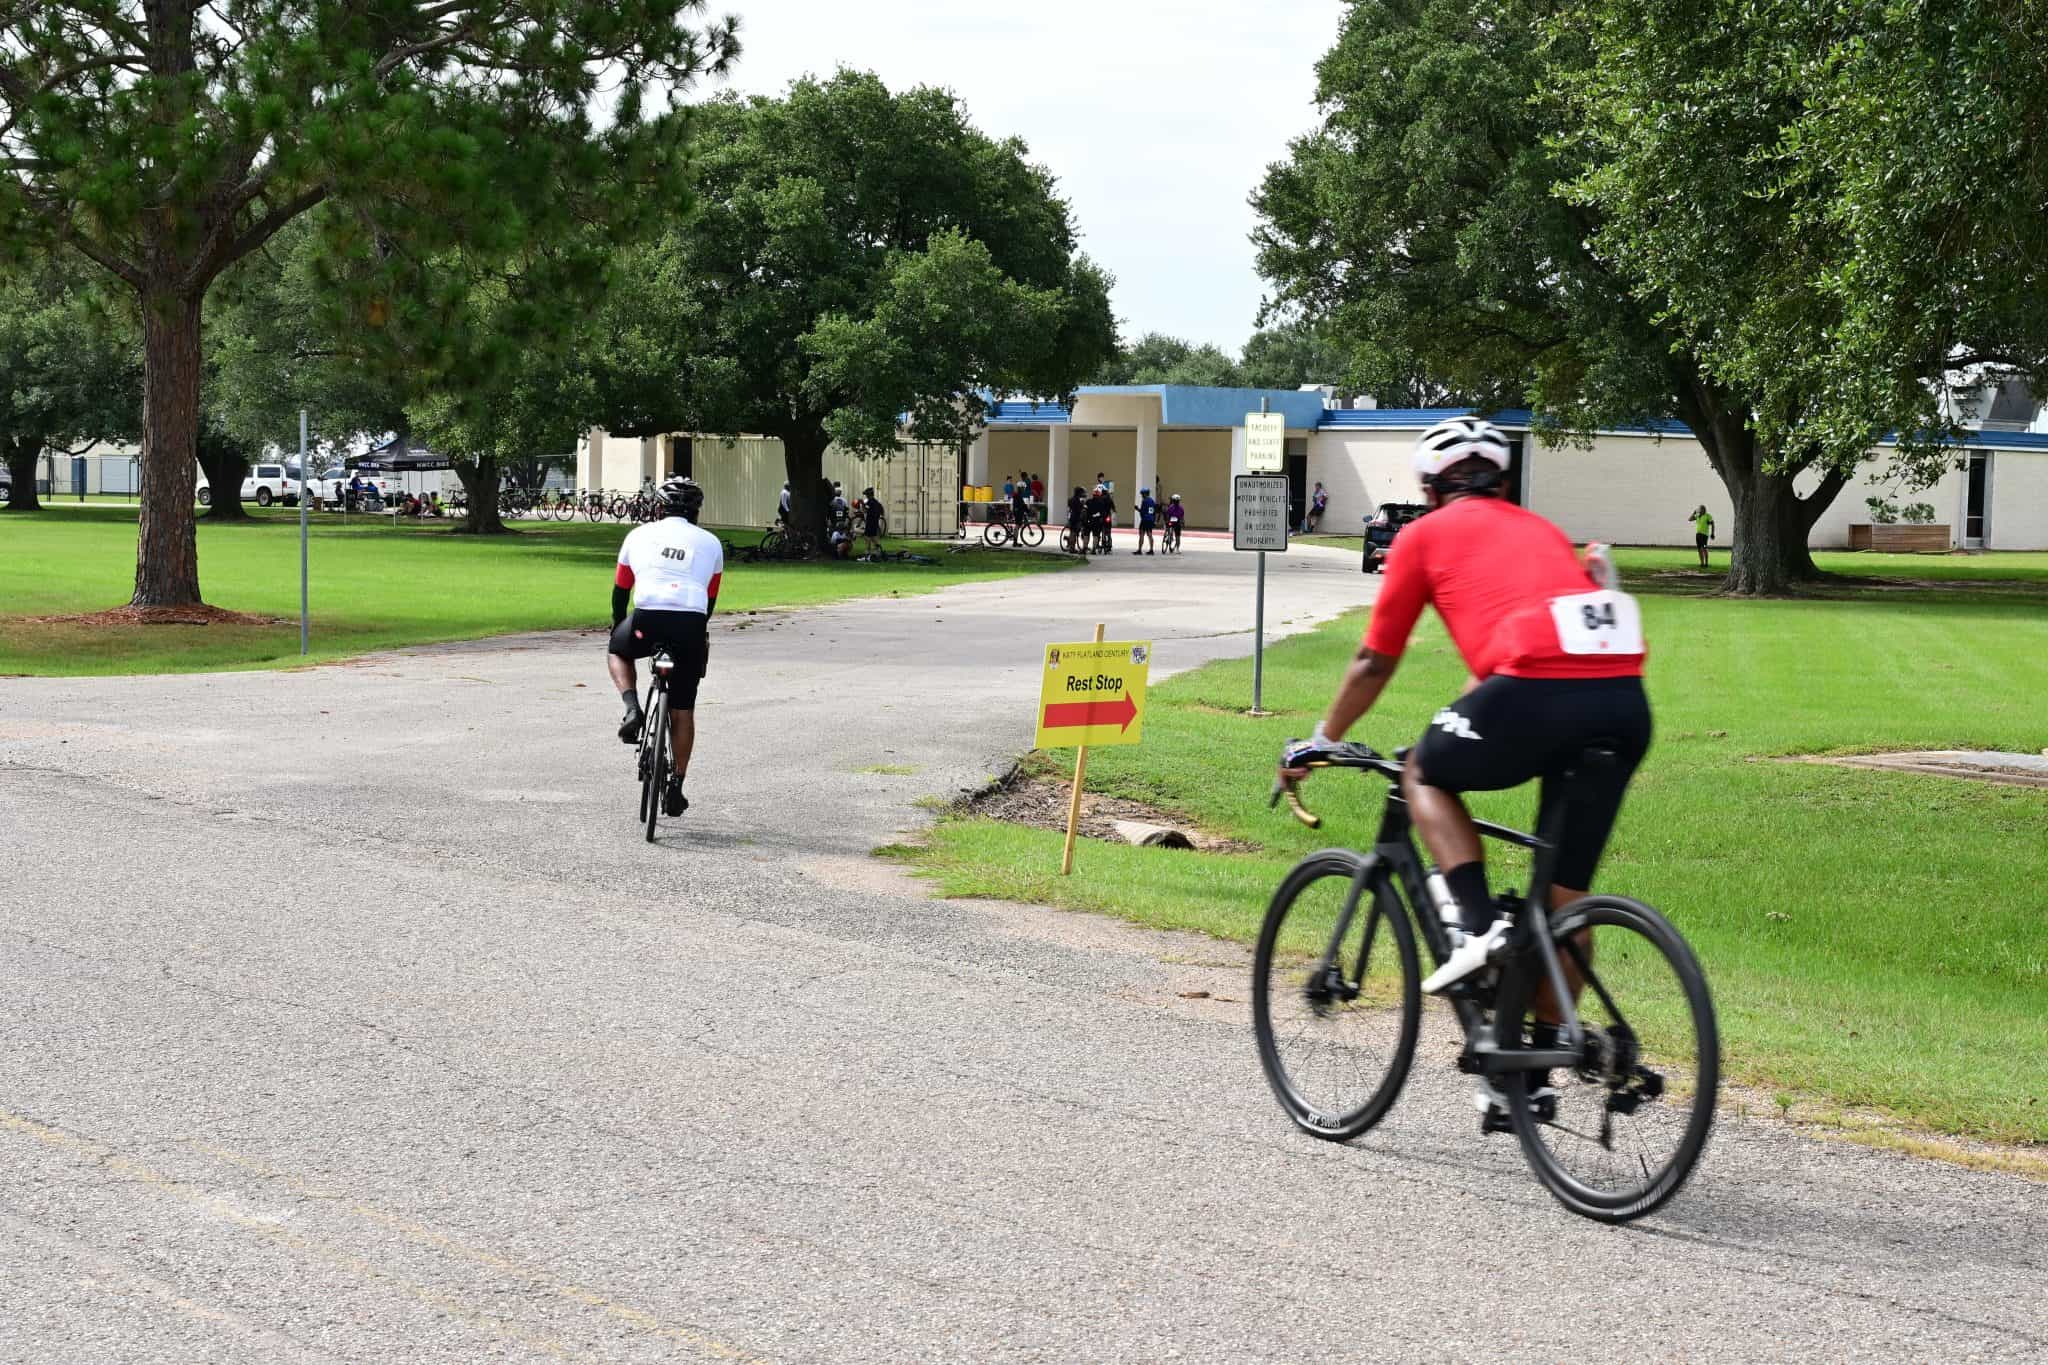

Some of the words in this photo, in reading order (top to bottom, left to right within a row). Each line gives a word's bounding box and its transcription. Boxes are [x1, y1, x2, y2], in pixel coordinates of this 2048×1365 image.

[1239, 479, 1284, 489] UNAUTHORIZED
[1237, 495, 1256, 503] MOTOR
[1259, 495, 1286, 504] VEHICLES
[1246, 535, 1275, 545] PROPERTY
[661, 546, 686, 561] 470
[1582, 602, 1617, 630] 84
[1078, 650, 1103, 658] FLATLAND
[1103, 648, 1129, 658] CENTURY
[1066, 675, 1093, 692] Rest
[1095, 674, 1123, 693] Stop
